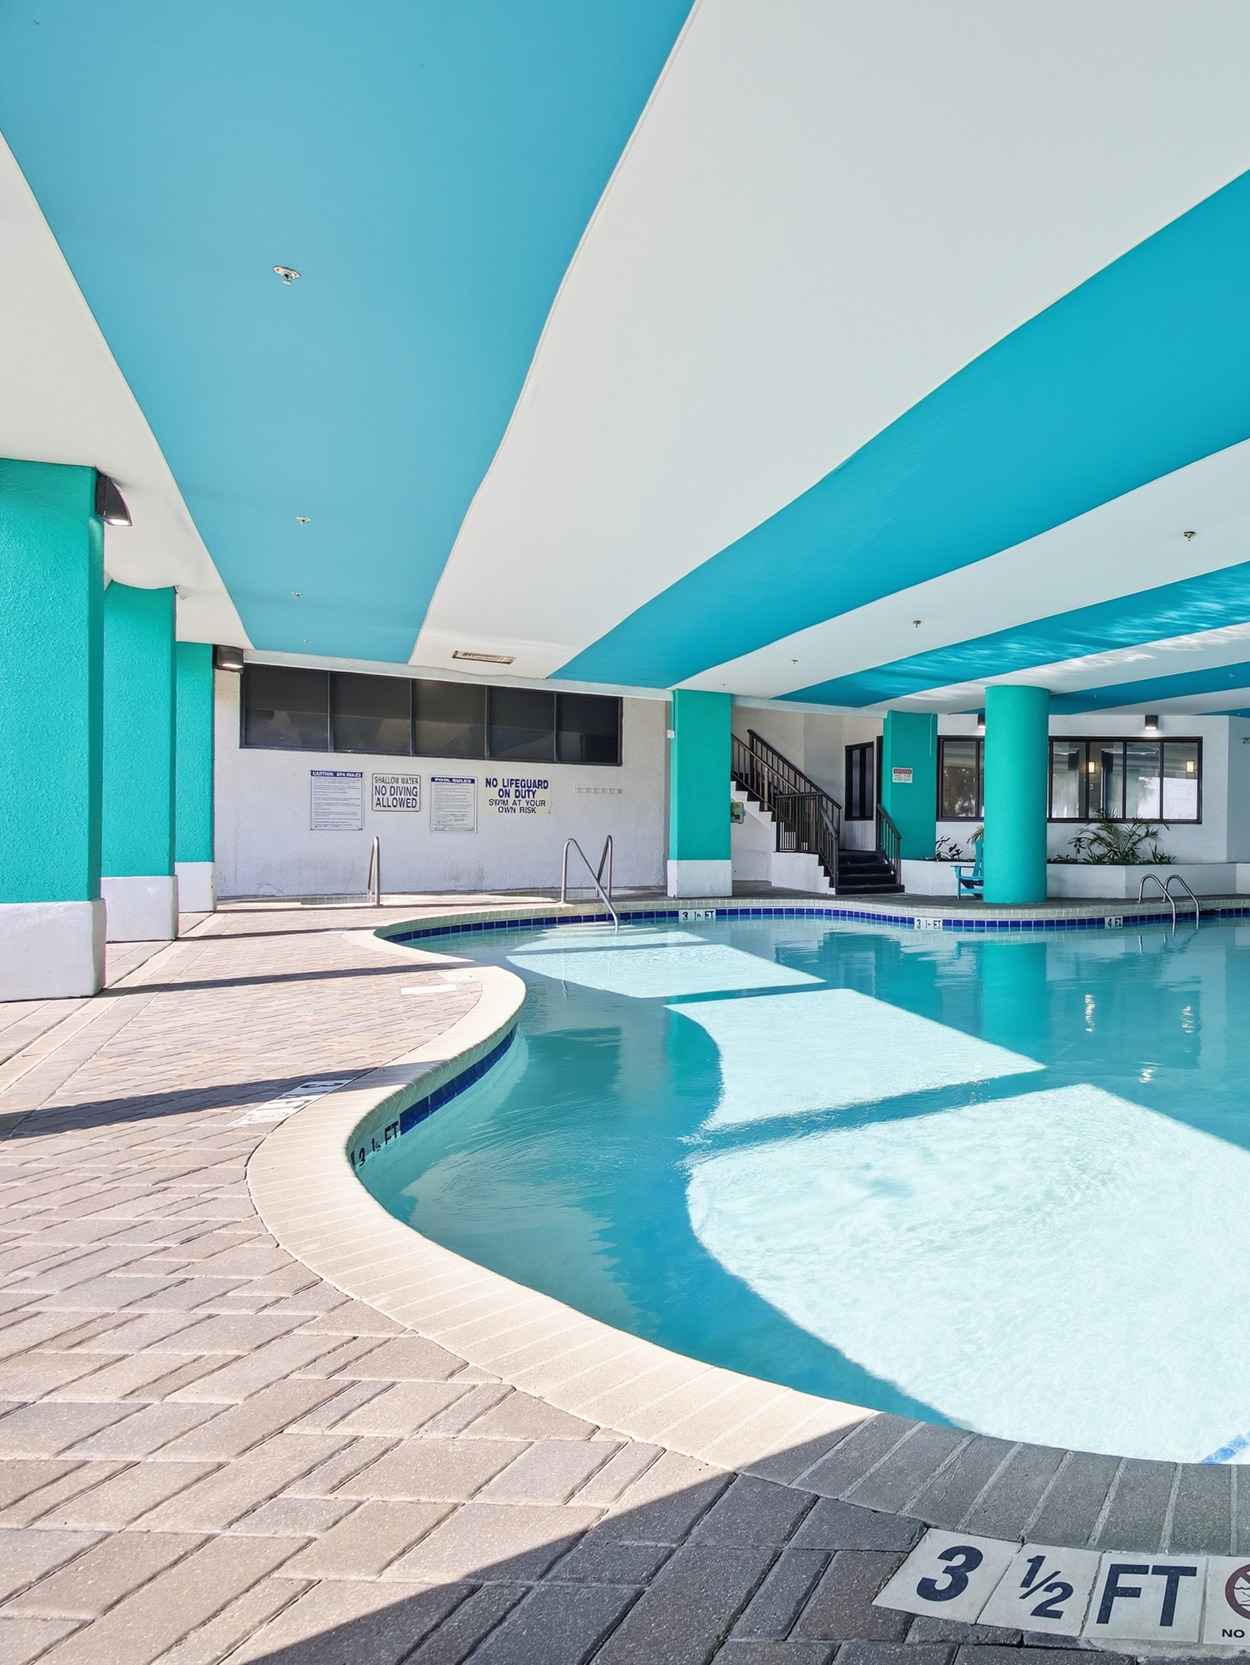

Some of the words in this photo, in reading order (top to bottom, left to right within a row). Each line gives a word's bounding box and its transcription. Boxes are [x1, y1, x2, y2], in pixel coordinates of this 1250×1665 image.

[374, 776, 399, 784] SHALLOW
[401, 776, 419, 785] WATER
[485, 777, 498, 788] NO
[502, 778, 549, 789] LIFEGUARD
[374, 785, 387, 796] NO
[389, 785, 418, 797] DIVING
[498, 788, 511, 798] ON
[514, 789, 537, 799] DUTY
[375, 797, 418, 808] ALLOWED
[488, 798, 509, 806] SWIM
[525, 799, 546, 807] YOUR
[682, 911, 689, 921] 3
[358, 1147, 366, 1167] 3
[384, 1120, 399, 1145] FT
[915, 1545, 983, 1602] 3
[1095, 1563, 1197, 1628] FT
[1220, 1628, 1246, 1639] NO
